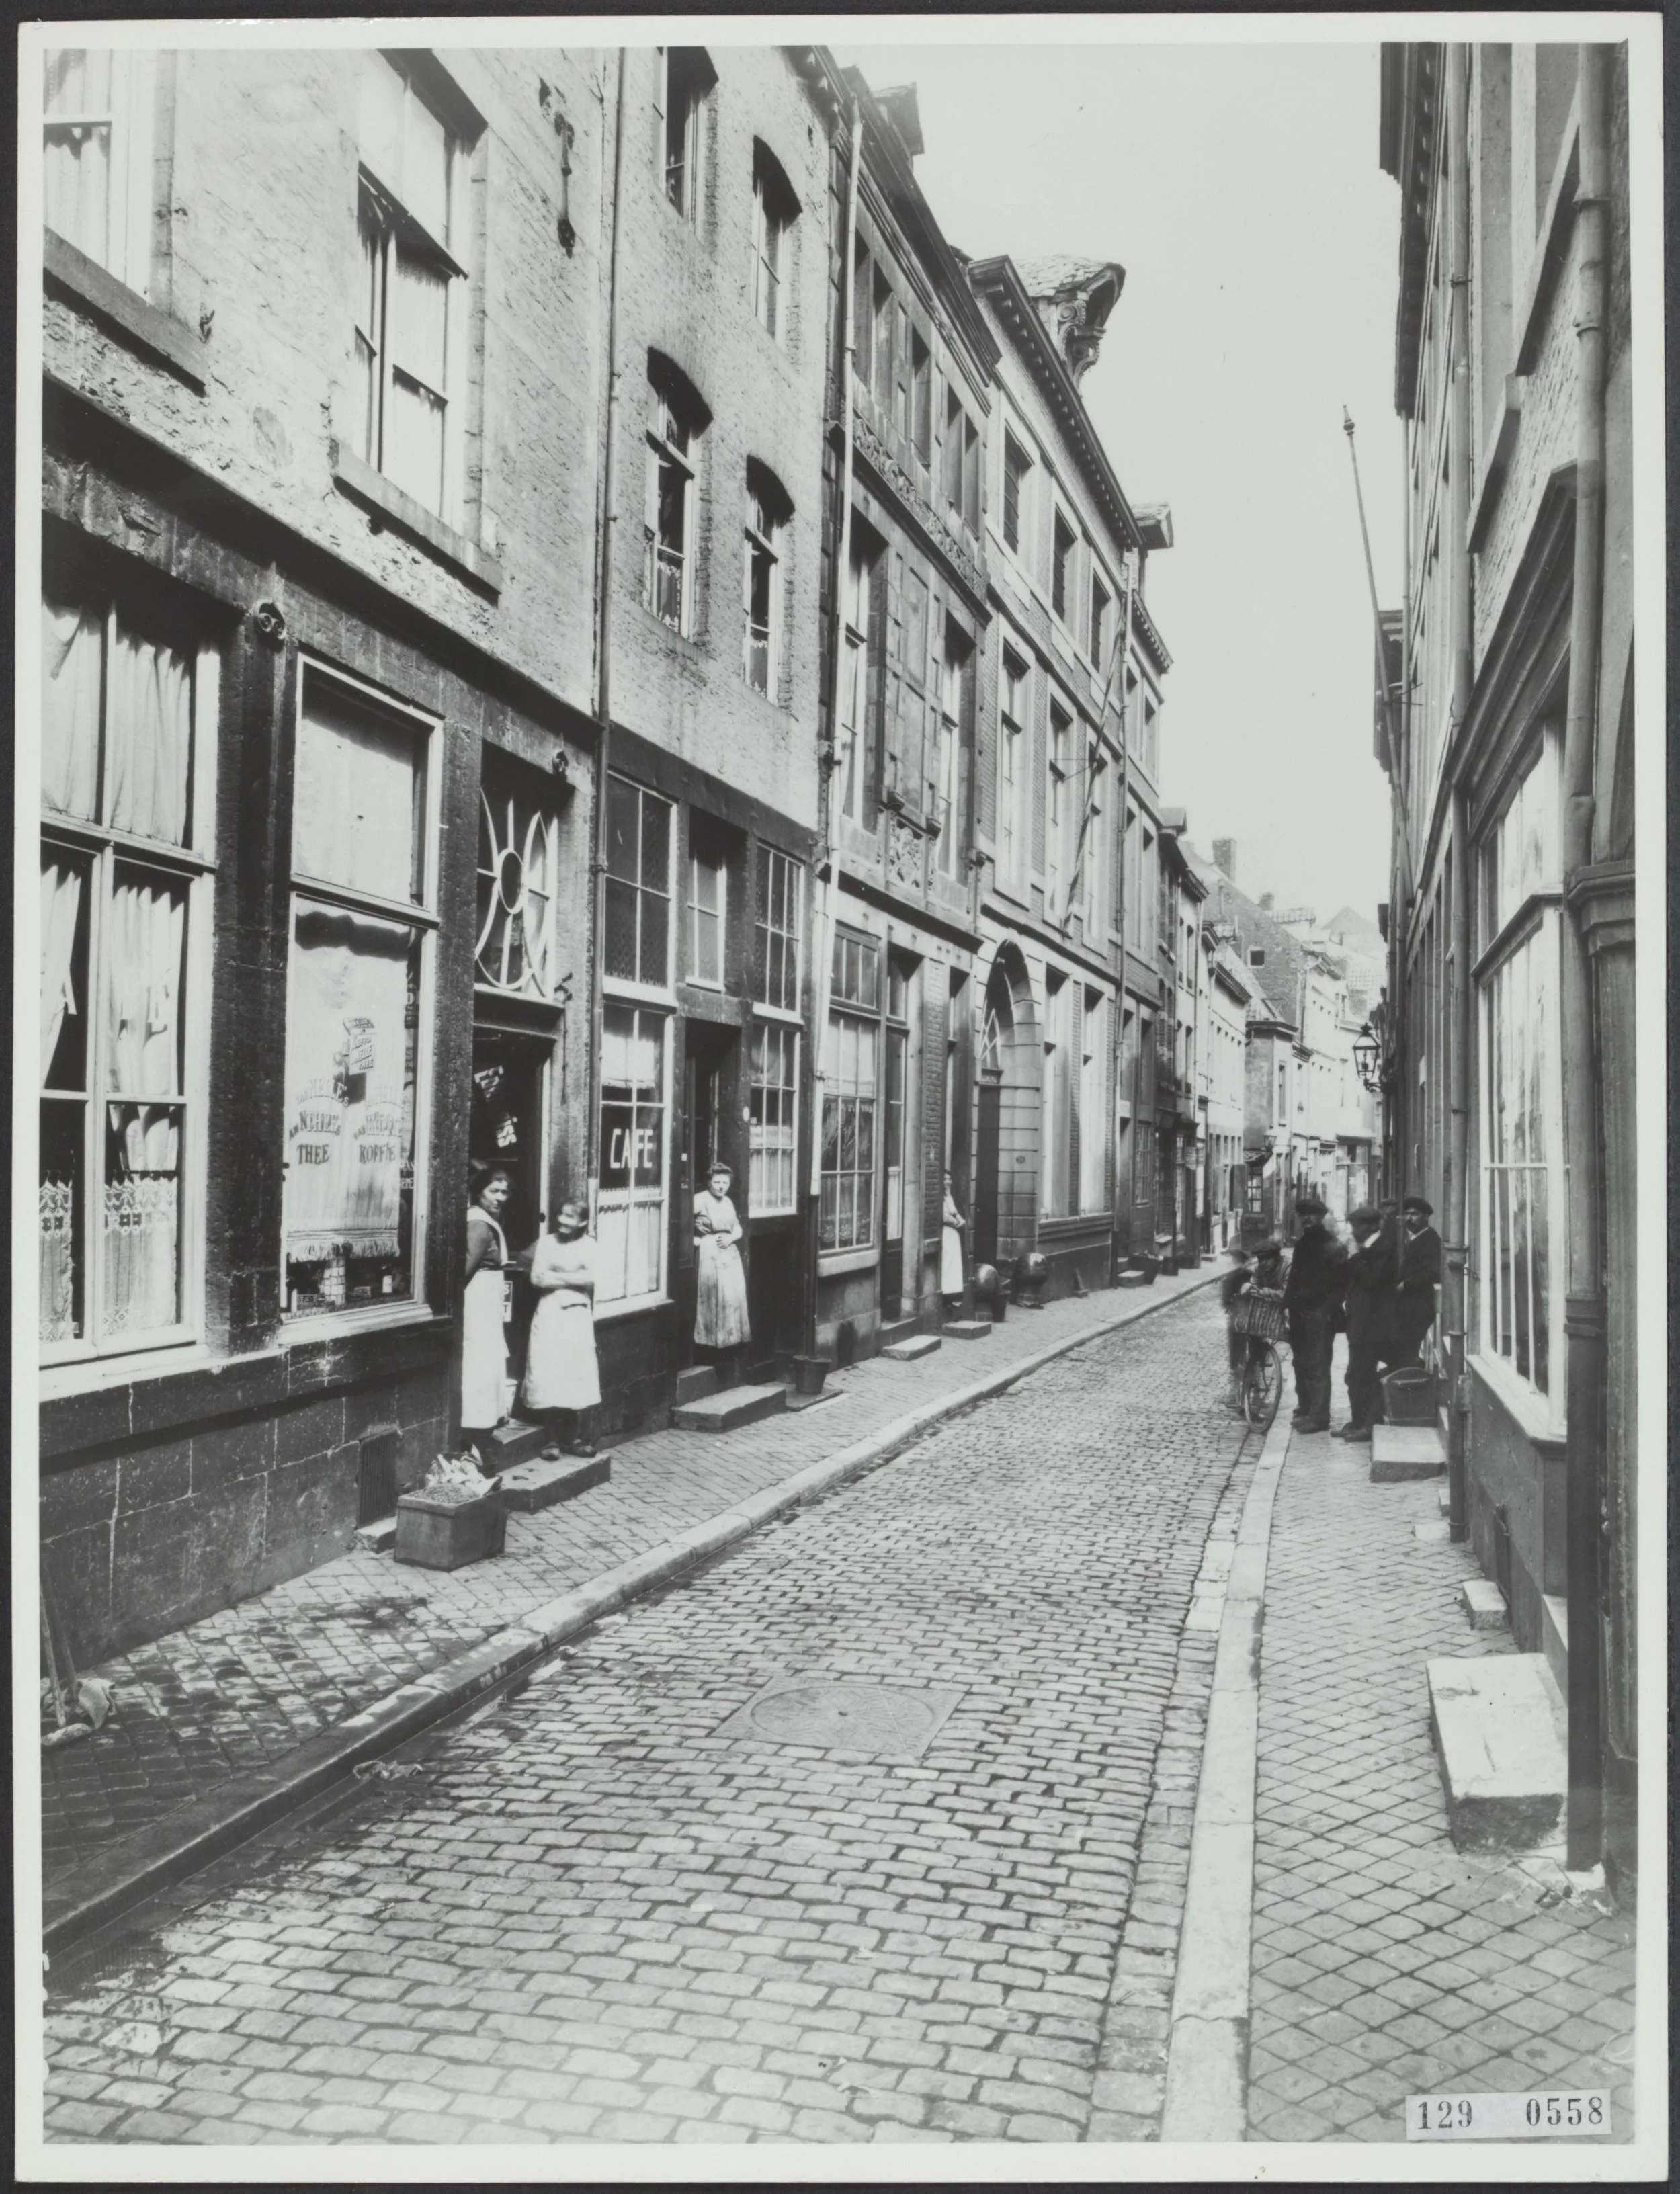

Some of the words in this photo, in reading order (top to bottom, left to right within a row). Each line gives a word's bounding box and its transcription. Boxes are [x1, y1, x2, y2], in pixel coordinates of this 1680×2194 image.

[296, 1144, 329, 1165] THEE
[359, 1142, 396, 1165] KOFFIE
[610, 1128, 653, 1168] CAFE
